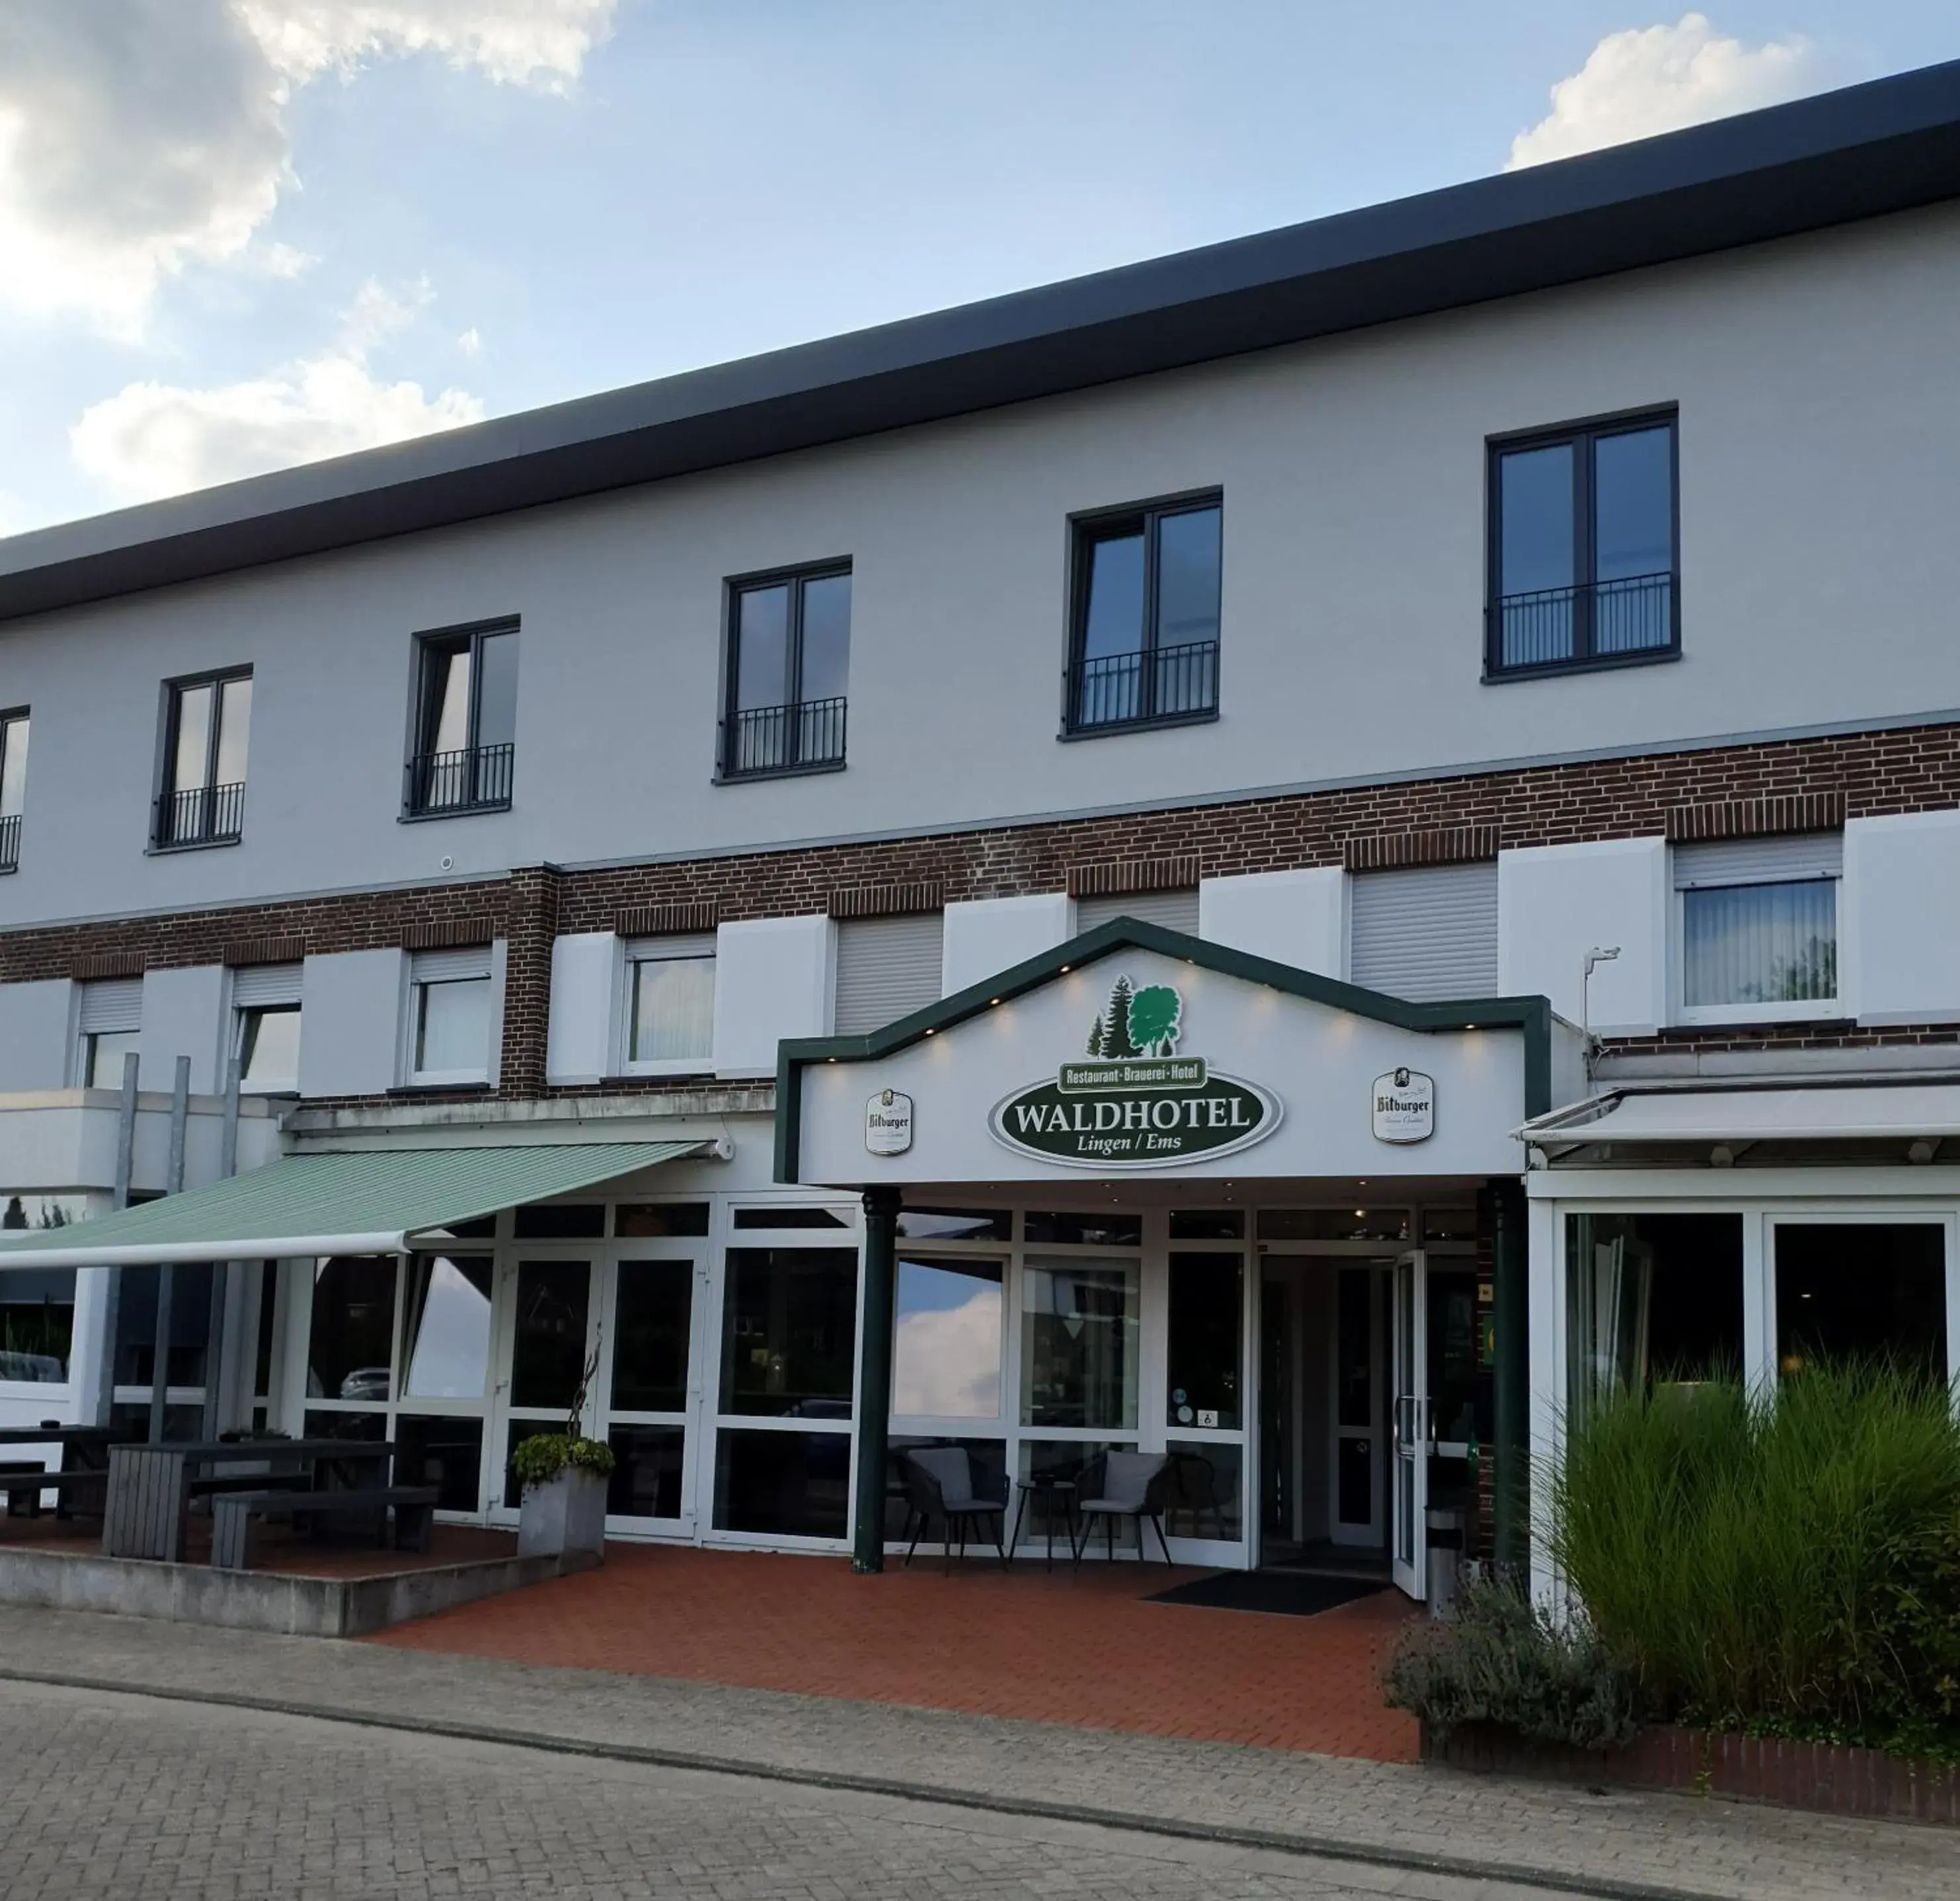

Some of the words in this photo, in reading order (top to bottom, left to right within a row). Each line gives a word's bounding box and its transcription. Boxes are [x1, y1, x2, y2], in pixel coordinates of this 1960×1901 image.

[1015, 1097, 1249, 1133] WALDHOTEL
[1376, 1096, 1429, 1114] Bitburger
[869, 1113, 908, 1129] Bitburger
[1077, 1134, 1132, 1156] Lingen
[1146, 1133, 1182, 1149] Ems
